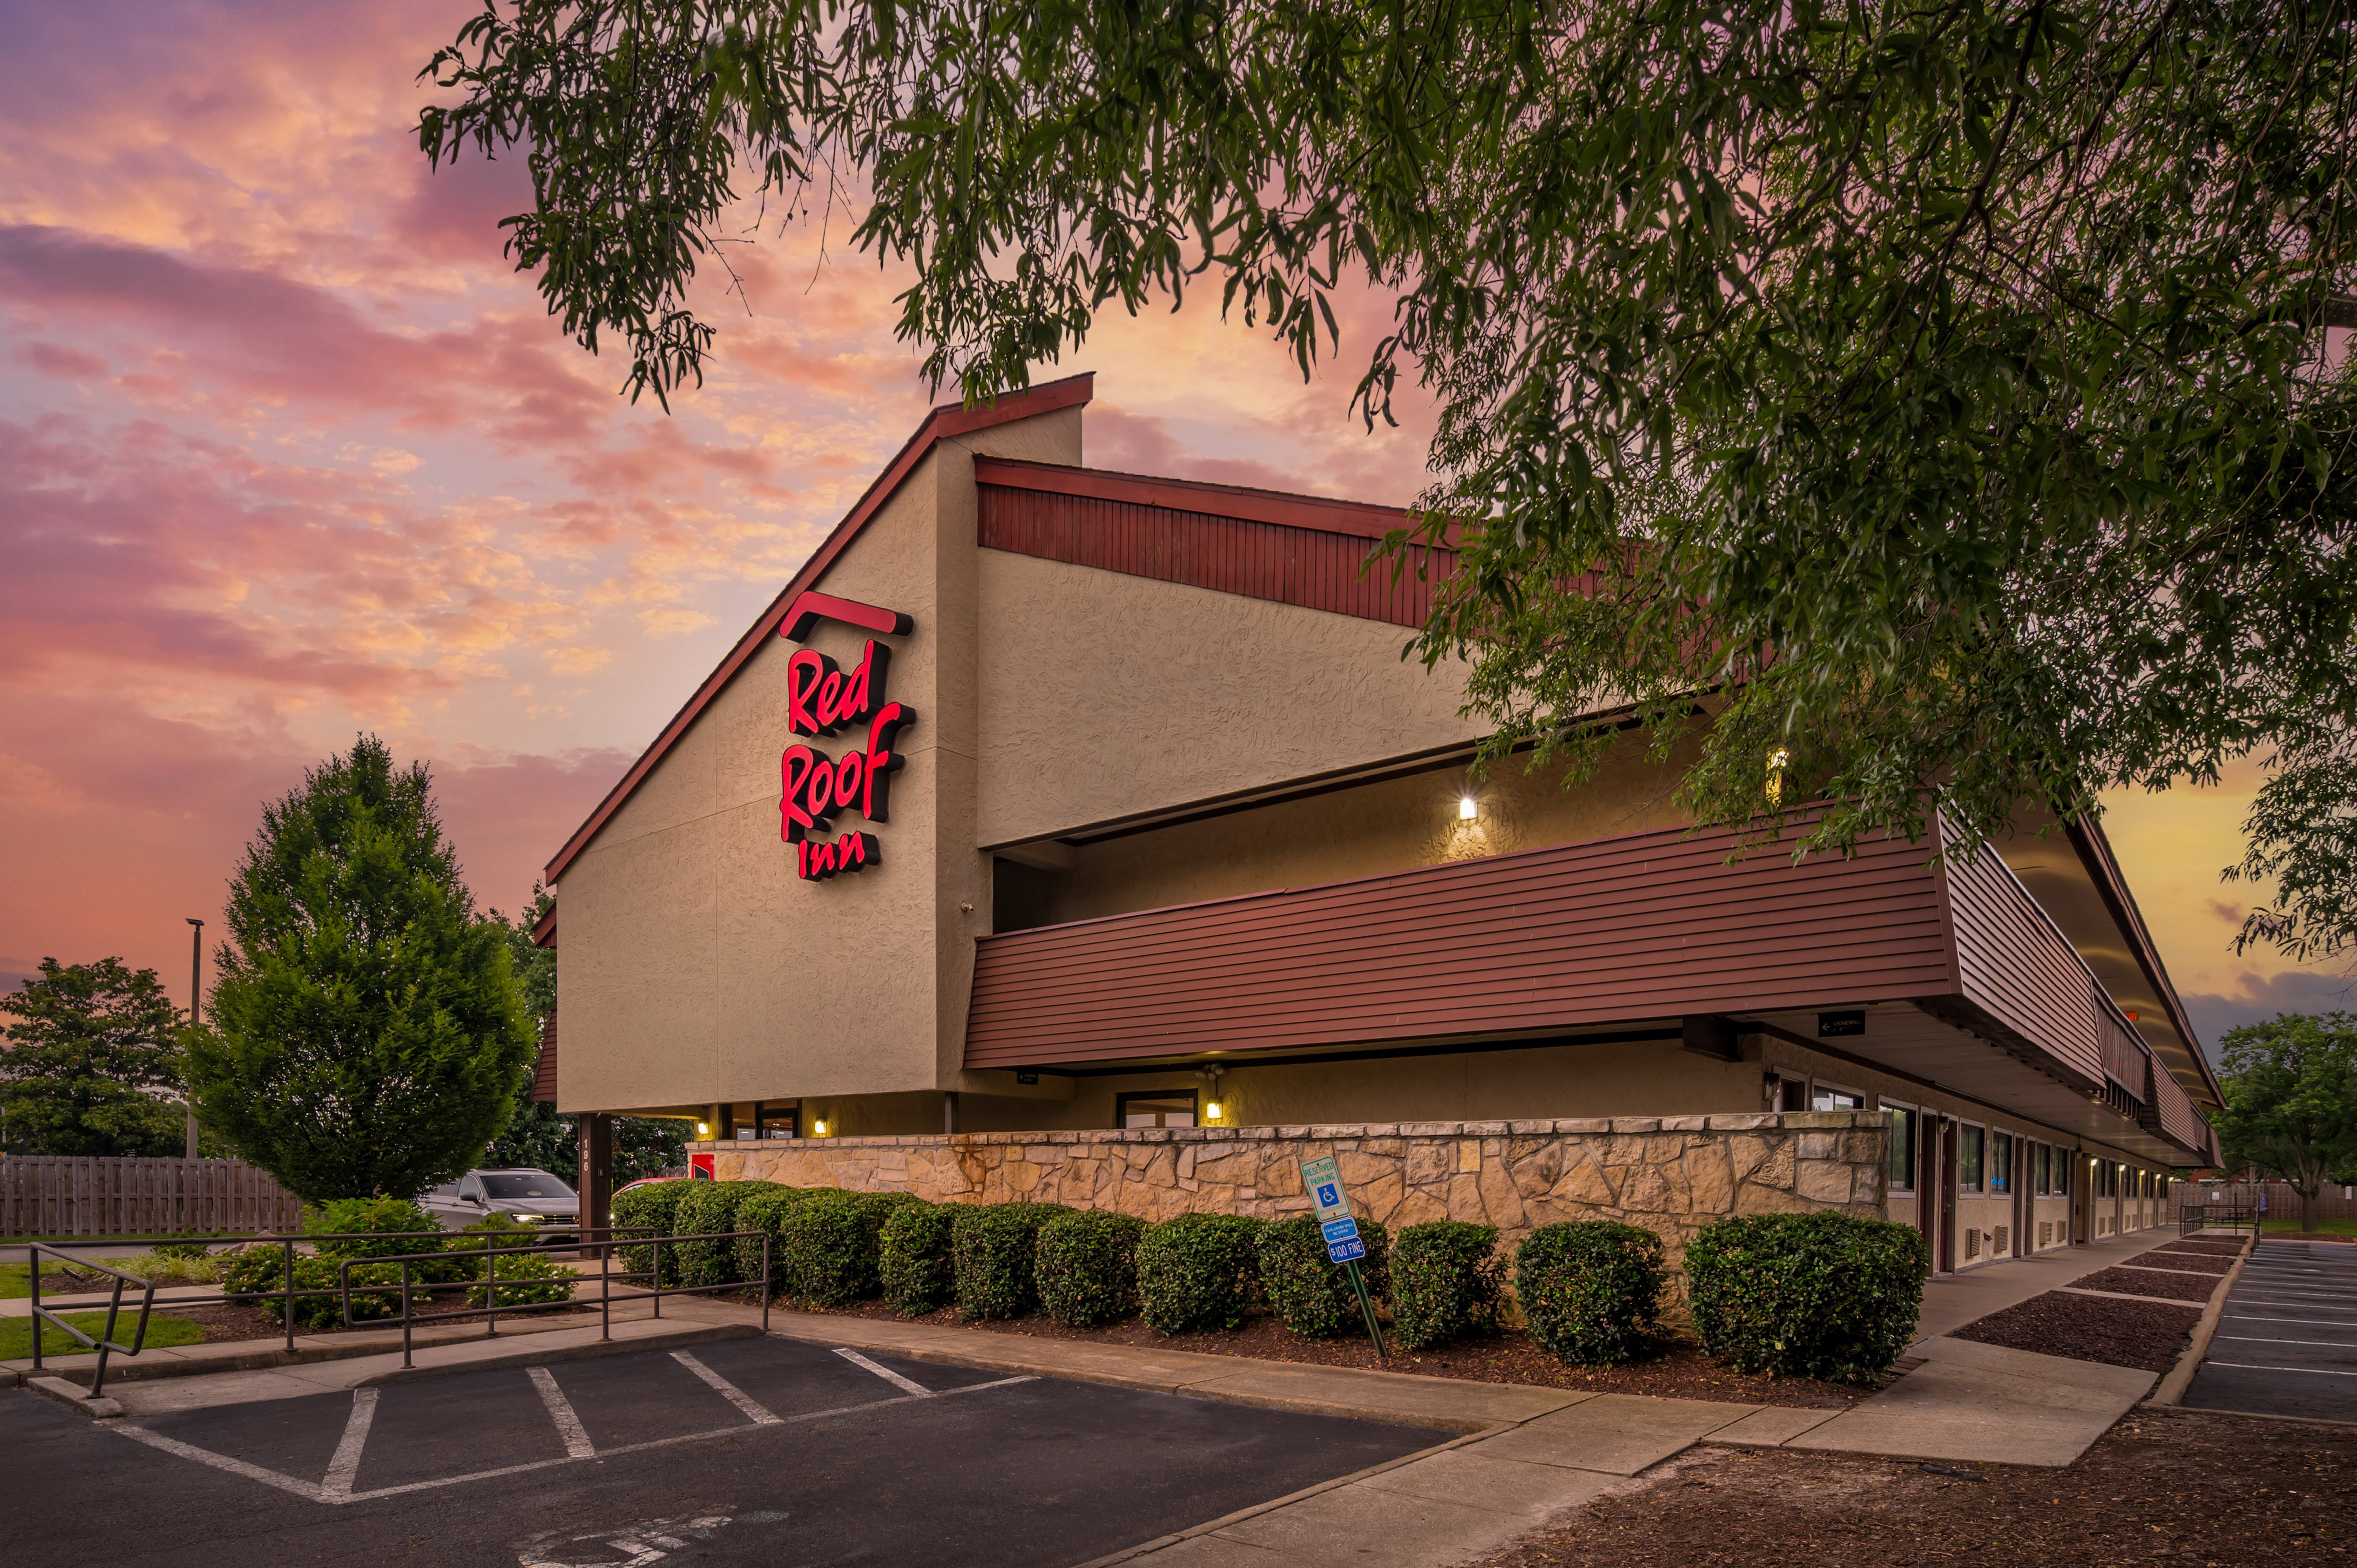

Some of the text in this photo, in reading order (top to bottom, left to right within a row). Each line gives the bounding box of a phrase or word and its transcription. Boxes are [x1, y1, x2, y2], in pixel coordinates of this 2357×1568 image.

[788, 639, 874, 734] Red
[779, 701, 901, 842] Roof
[799, 831, 865, 879] Inn
[1304, 1162, 1334, 1177] RESERVED
[1310, 1172, 1335, 1186] PARKING
[1330, 1241, 1363, 1257] $100 FINE
